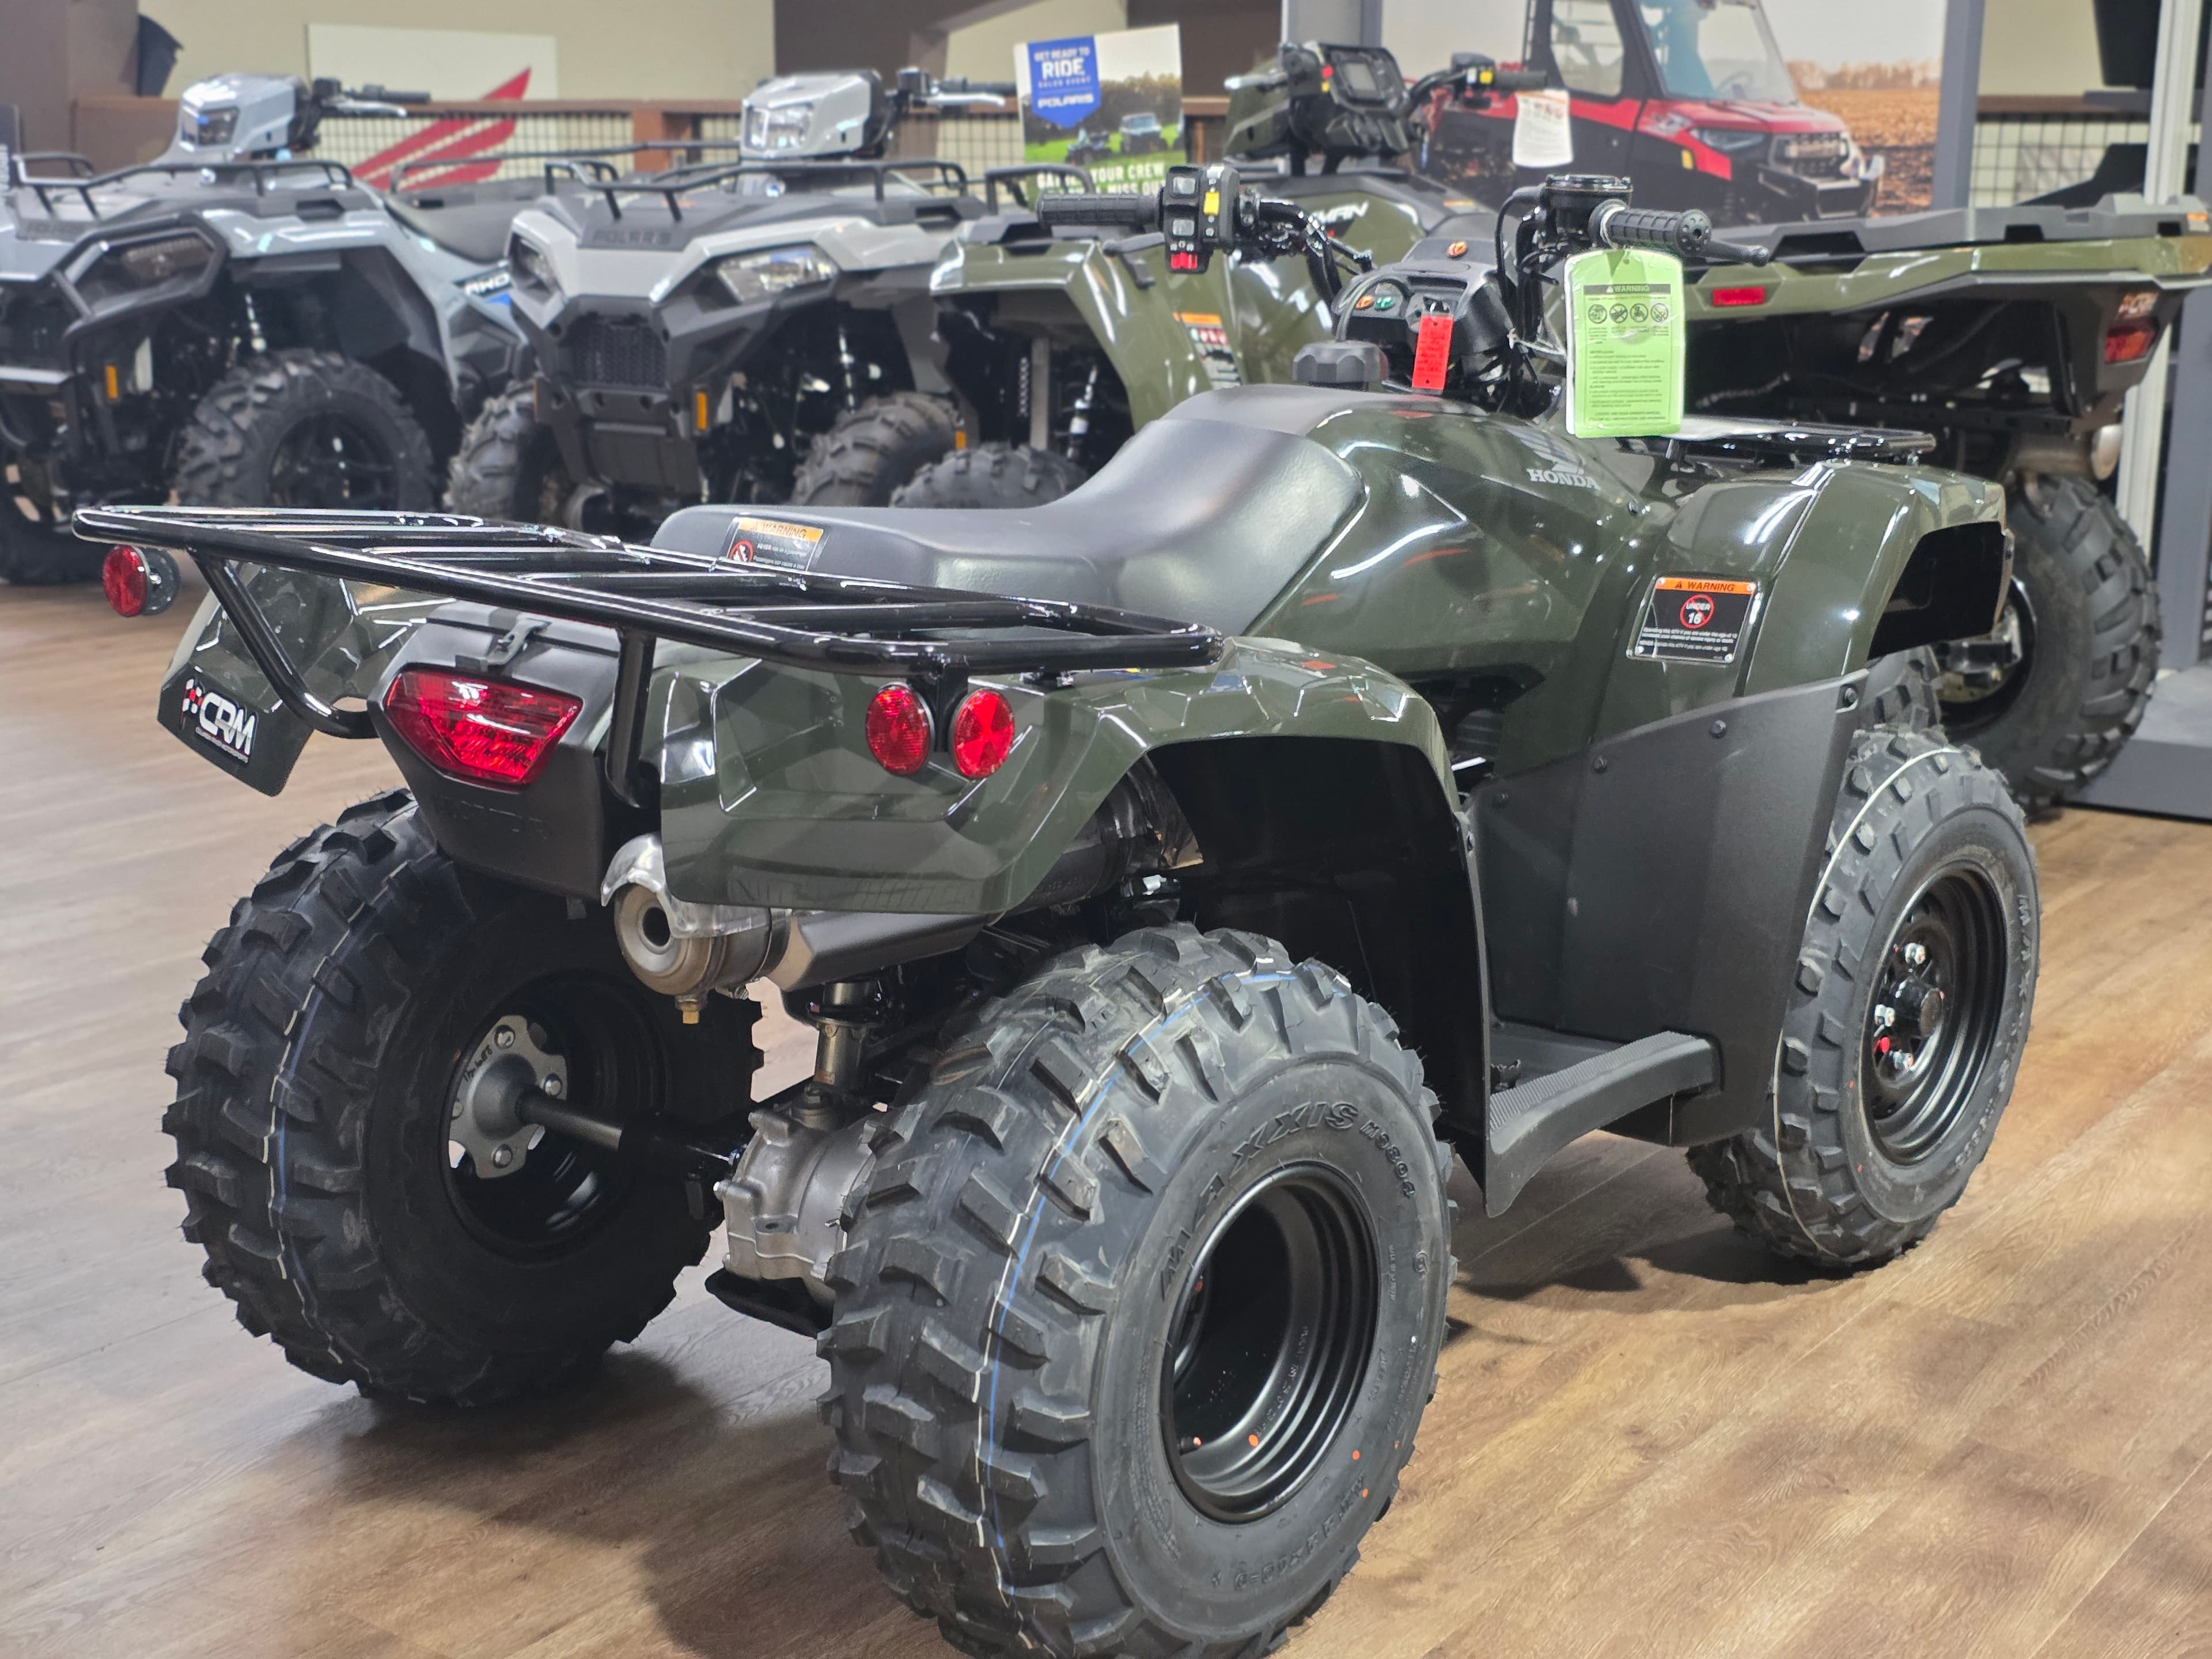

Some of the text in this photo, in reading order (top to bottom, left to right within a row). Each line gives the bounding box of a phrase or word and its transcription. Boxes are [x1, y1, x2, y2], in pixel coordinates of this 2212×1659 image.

[1051, 48, 1077, 59] READY
[1079, 46, 1090, 57] TO
[1041, 58, 1085, 80] RIDE
[1037, 93, 1093, 108] POLARIS
[1090, 165, 1124, 183] YOUR
[1127, 162, 1165, 180] CREW
[1613, 285, 1650, 293] WARNING
[1526, 468, 1601, 491] HONDA
[762, 522, 807, 539] WARNING
[1687, 581, 1735, 592] WARNING
[1685, 602, 1711, 611] UNDER
[1688, 612, 1702, 624] 16
[199, 692, 255, 756] CRM
[1160, 1101, 1359, 1301] MAXXIS
